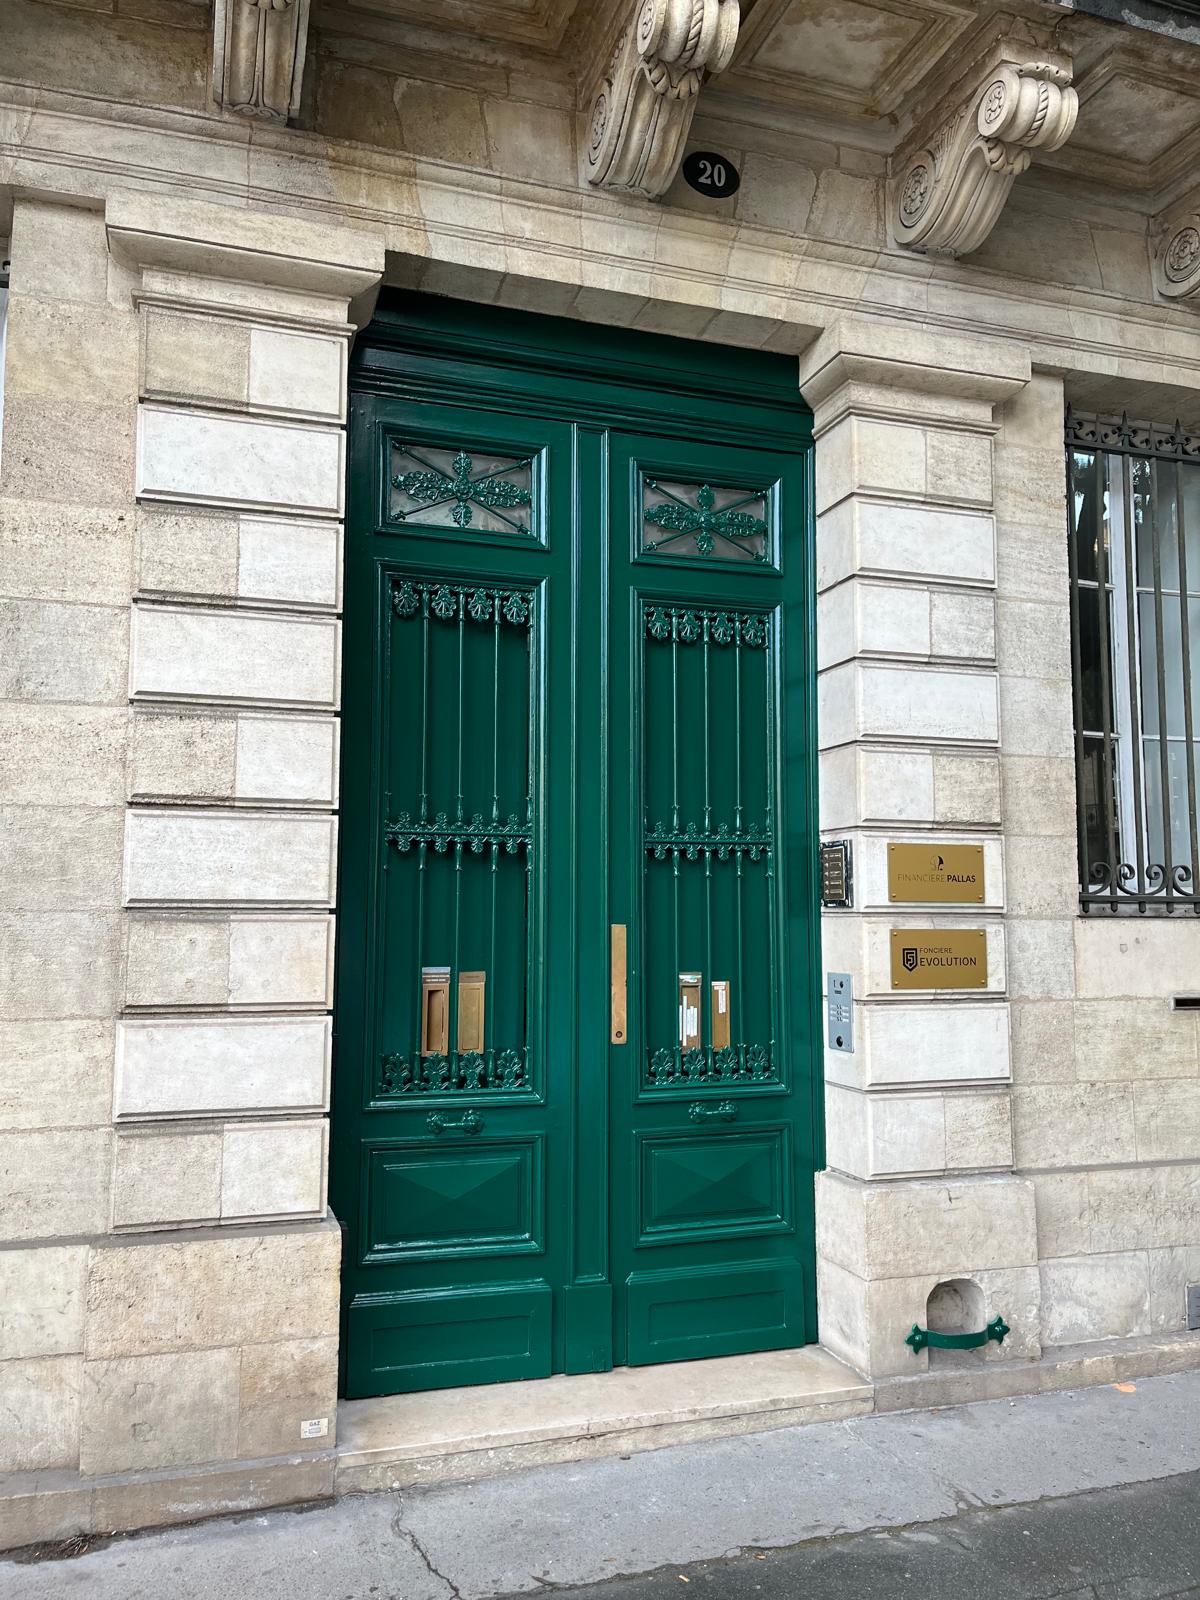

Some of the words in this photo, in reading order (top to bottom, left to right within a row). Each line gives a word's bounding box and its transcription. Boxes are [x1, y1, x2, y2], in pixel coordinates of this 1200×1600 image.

[698, 160, 726, 187] 20
[947, 874, 976, 883] PALLAS
[919, 957, 977, 967] EVOLUTION
